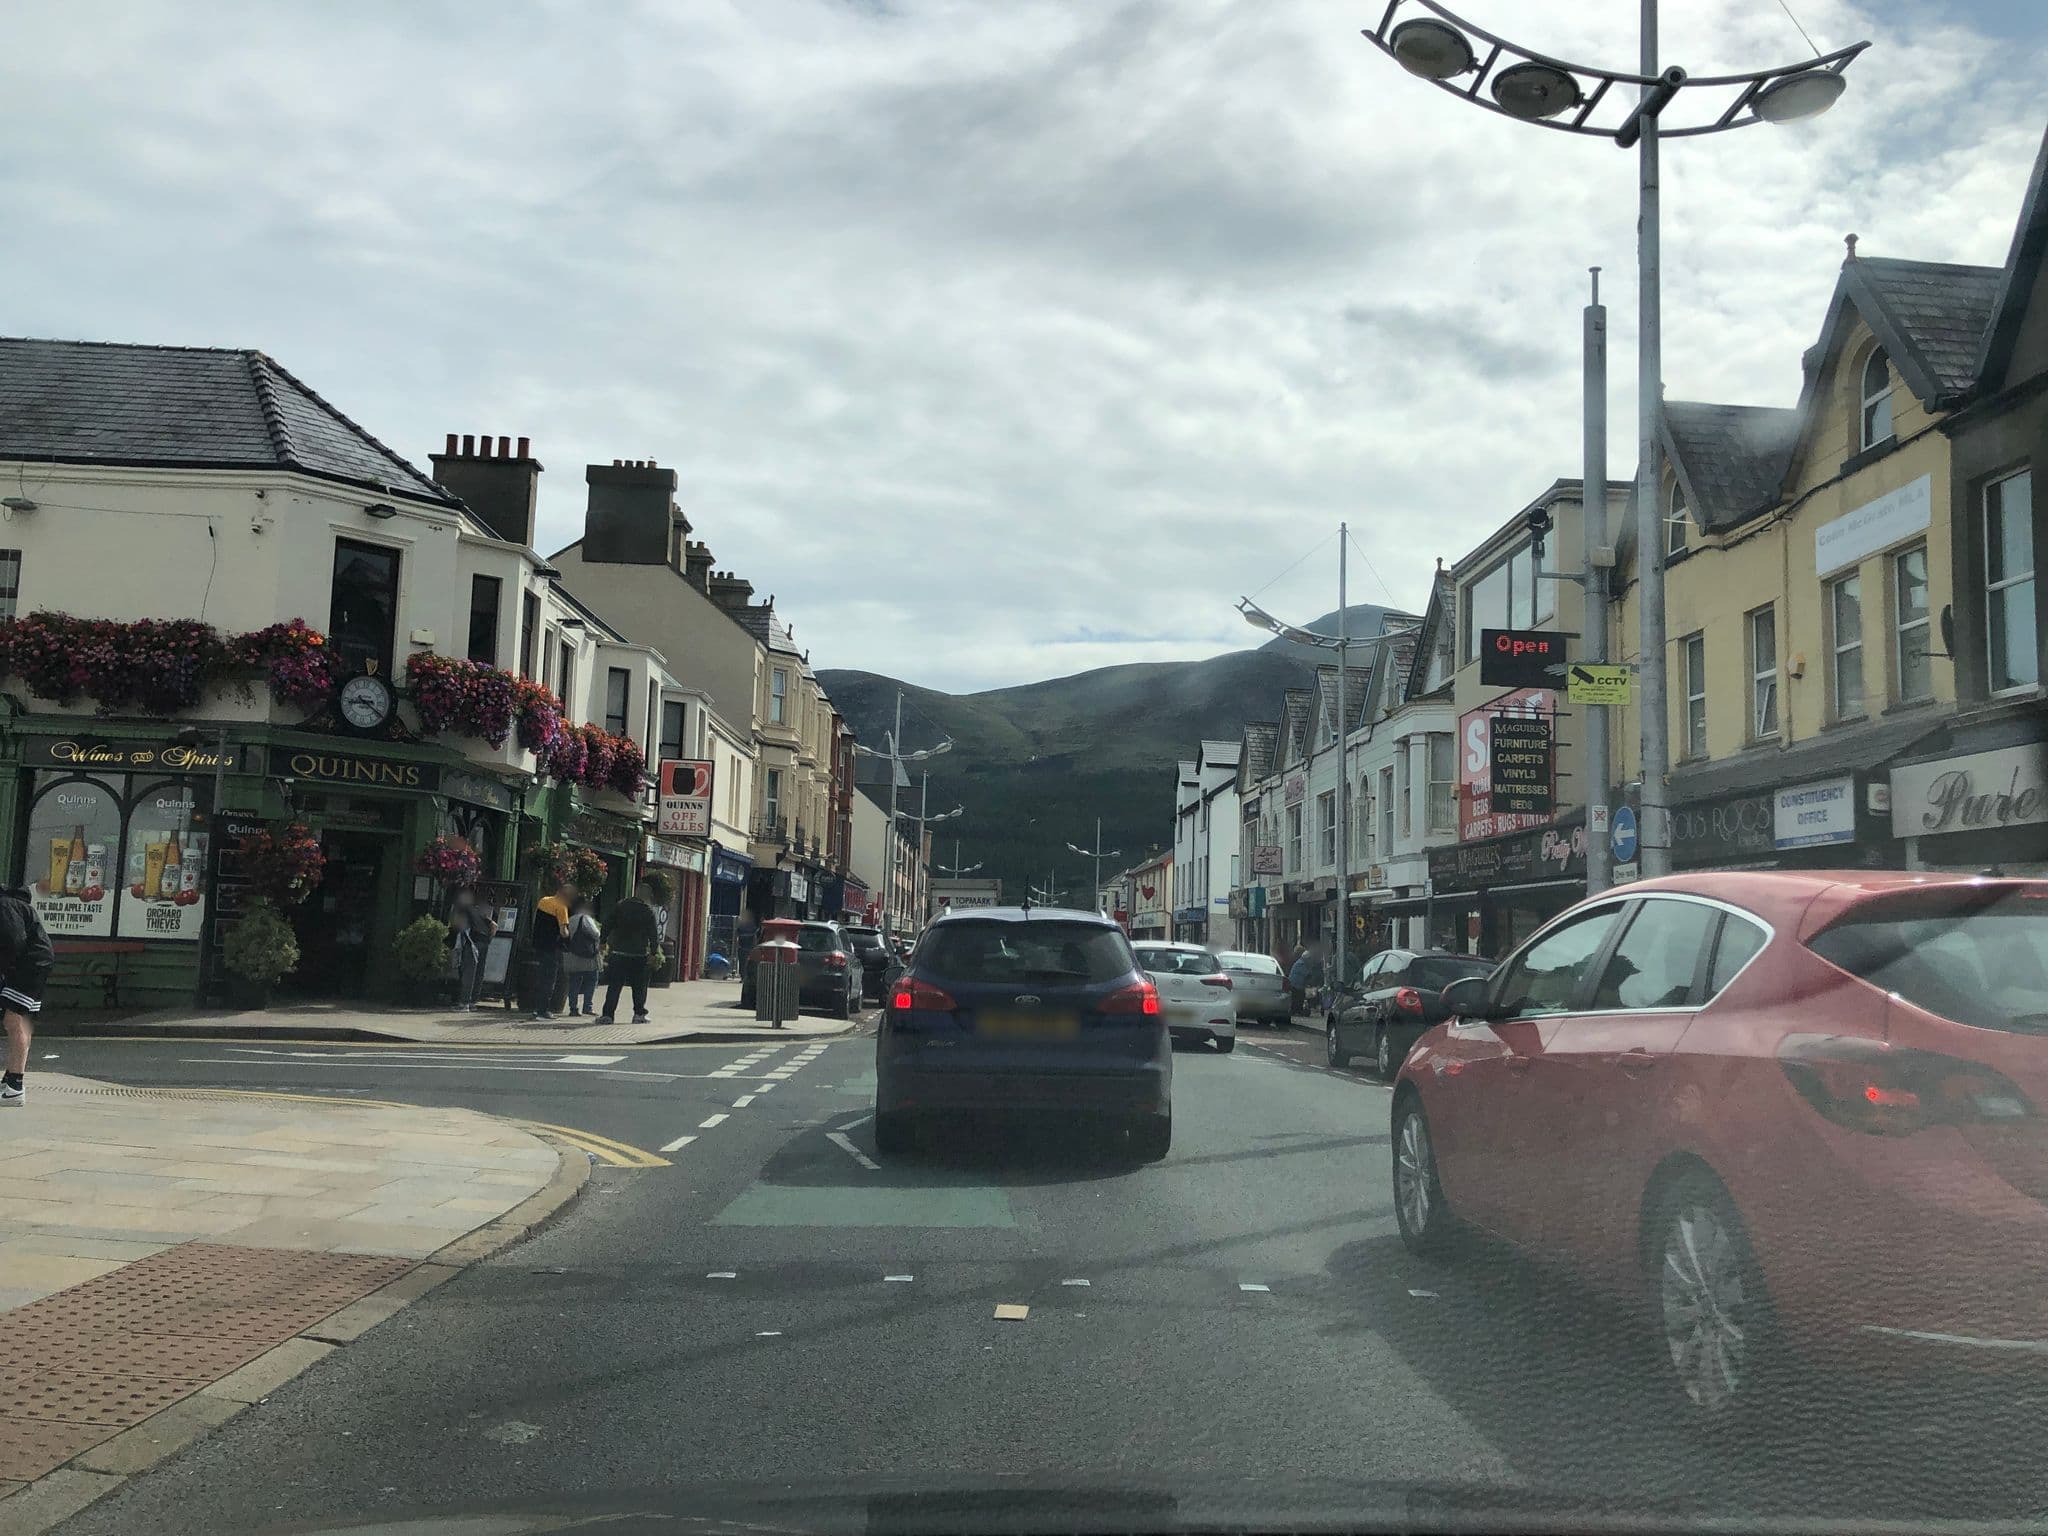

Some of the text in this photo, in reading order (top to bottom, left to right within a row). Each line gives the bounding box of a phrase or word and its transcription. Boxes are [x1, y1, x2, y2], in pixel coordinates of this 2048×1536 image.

[1496, 634, 1549, 657] Open
[1597, 677, 1627, 686] CCTV
[1495, 723, 1548, 736] MAGUIRES
[1494, 738, 1548, 750] FURNITURE
[50, 741, 124, 763] Wines
[161, 746, 233, 770] Spiris
[1497, 753, 1544, 765] CARPETS
[291, 754, 419, 786] QUINNS
[1503, 769, 1537, 779] VINYLS
[1494, 783, 1548, 795] MATTRESSES
[57, 794, 97, 805] Quinns
[1780, 785, 1846, 809] CONSTITUENCY
[156, 798, 195, 809] Quinns
[666, 801, 704, 810] QUINNS
[1510, 799, 1533, 810] BEDS
[671, 811, 697, 821] OFF
[1797, 809, 1828, 825] OFFICE
[662, 820, 704, 832] SALES
[1465, 819, 1493, 840] CARPETS
[1498, 814, 1517, 833] RUGS
[955, 896, 993, 905] TOPMARK
[36, 901, 47, 911] THE
[64, 903, 81, 912] APPLE
[84, 904, 103, 913] TASTE
[146, 908, 182, 918] ORCHARD
[44, 913, 93, 923] WORTH THIEVING
[146, 917, 181, 929] THIEVES
